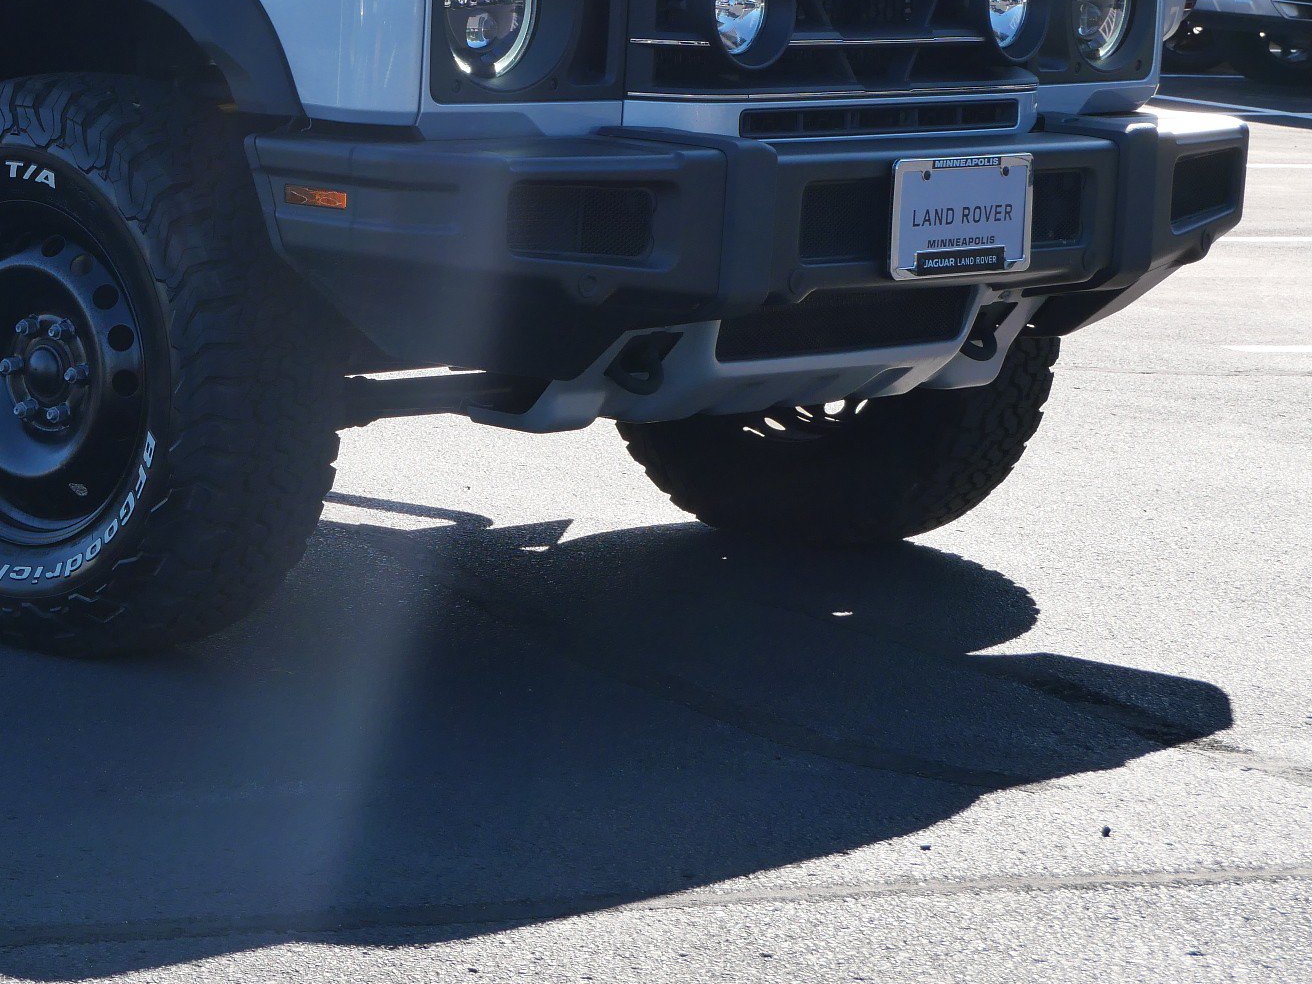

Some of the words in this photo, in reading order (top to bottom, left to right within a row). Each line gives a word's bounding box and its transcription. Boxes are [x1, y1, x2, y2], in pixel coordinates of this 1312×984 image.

[934, 157, 1000, 168] MINNEAPOLIS
[5, 160, 57, 190] T/A
[913, 208, 955, 227] LAND
[961, 204, 1013, 224] ROVER
[927, 235, 995, 248] MINNEAPOLIS
[923, 257, 955, 268] JAGUAR
[957, 257, 974, 266] LAND
[975, 255, 997, 264] ROVER
